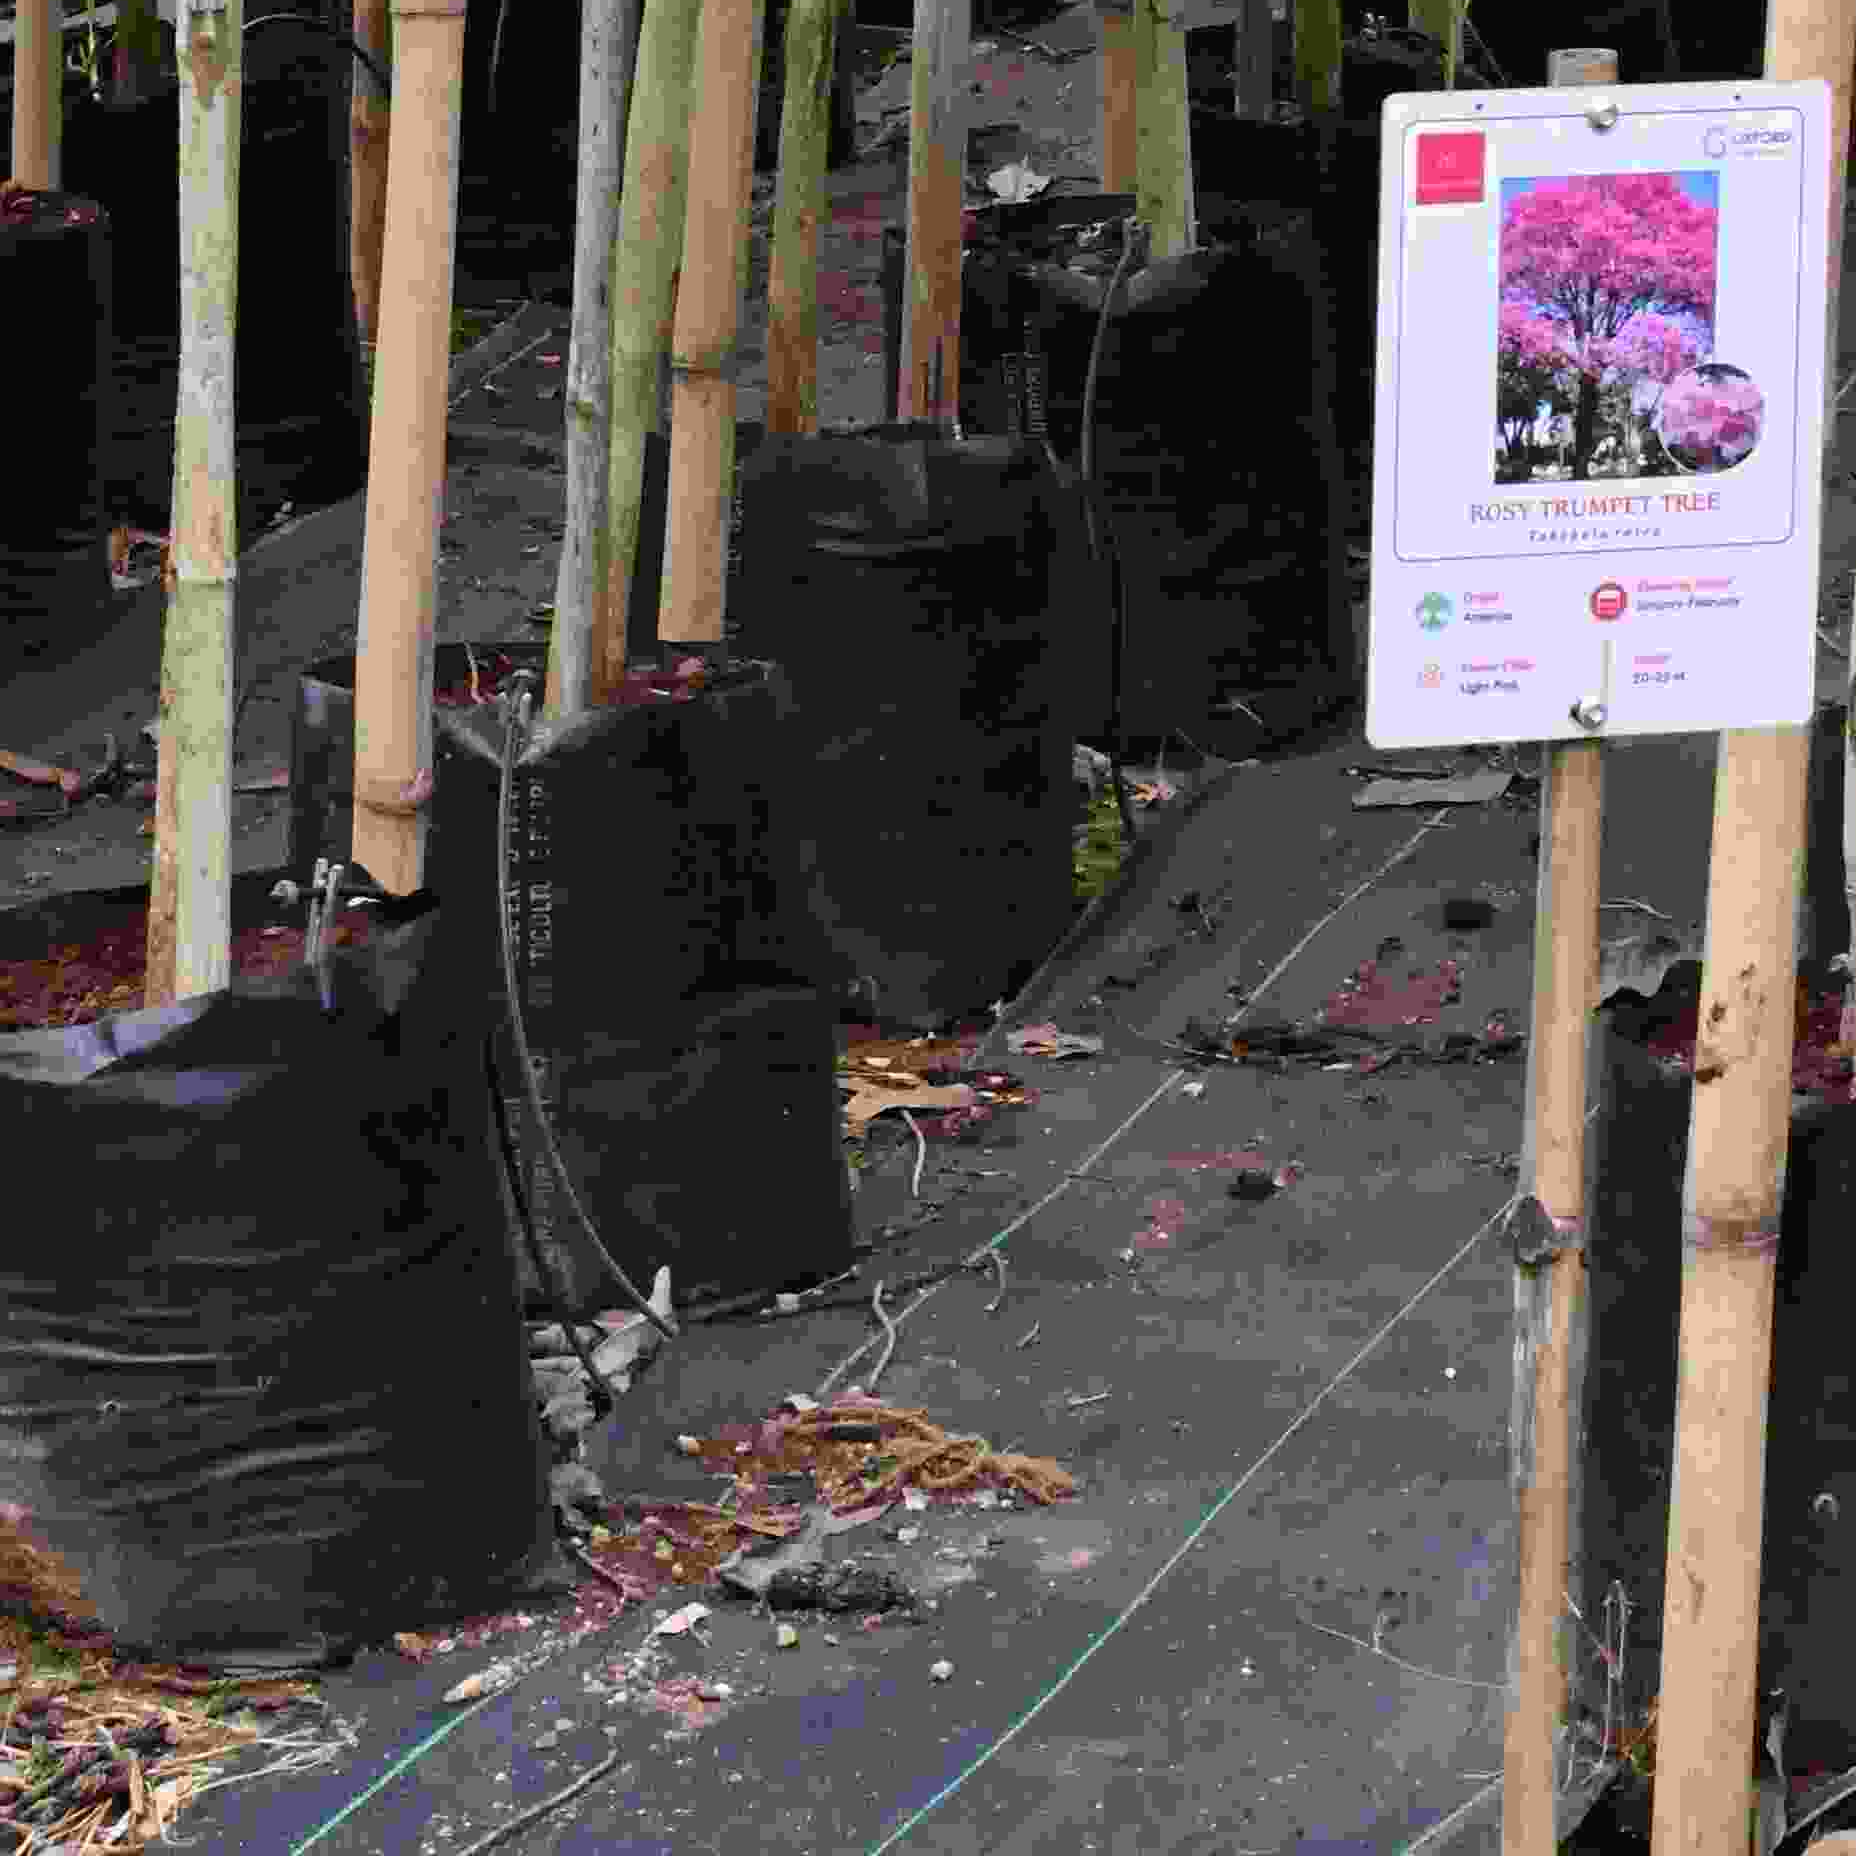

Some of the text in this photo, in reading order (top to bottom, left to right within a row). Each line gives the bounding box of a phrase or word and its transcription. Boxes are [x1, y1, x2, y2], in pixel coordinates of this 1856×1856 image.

[1471, 489, 1721, 525] ROSY TRUMPET TREE
